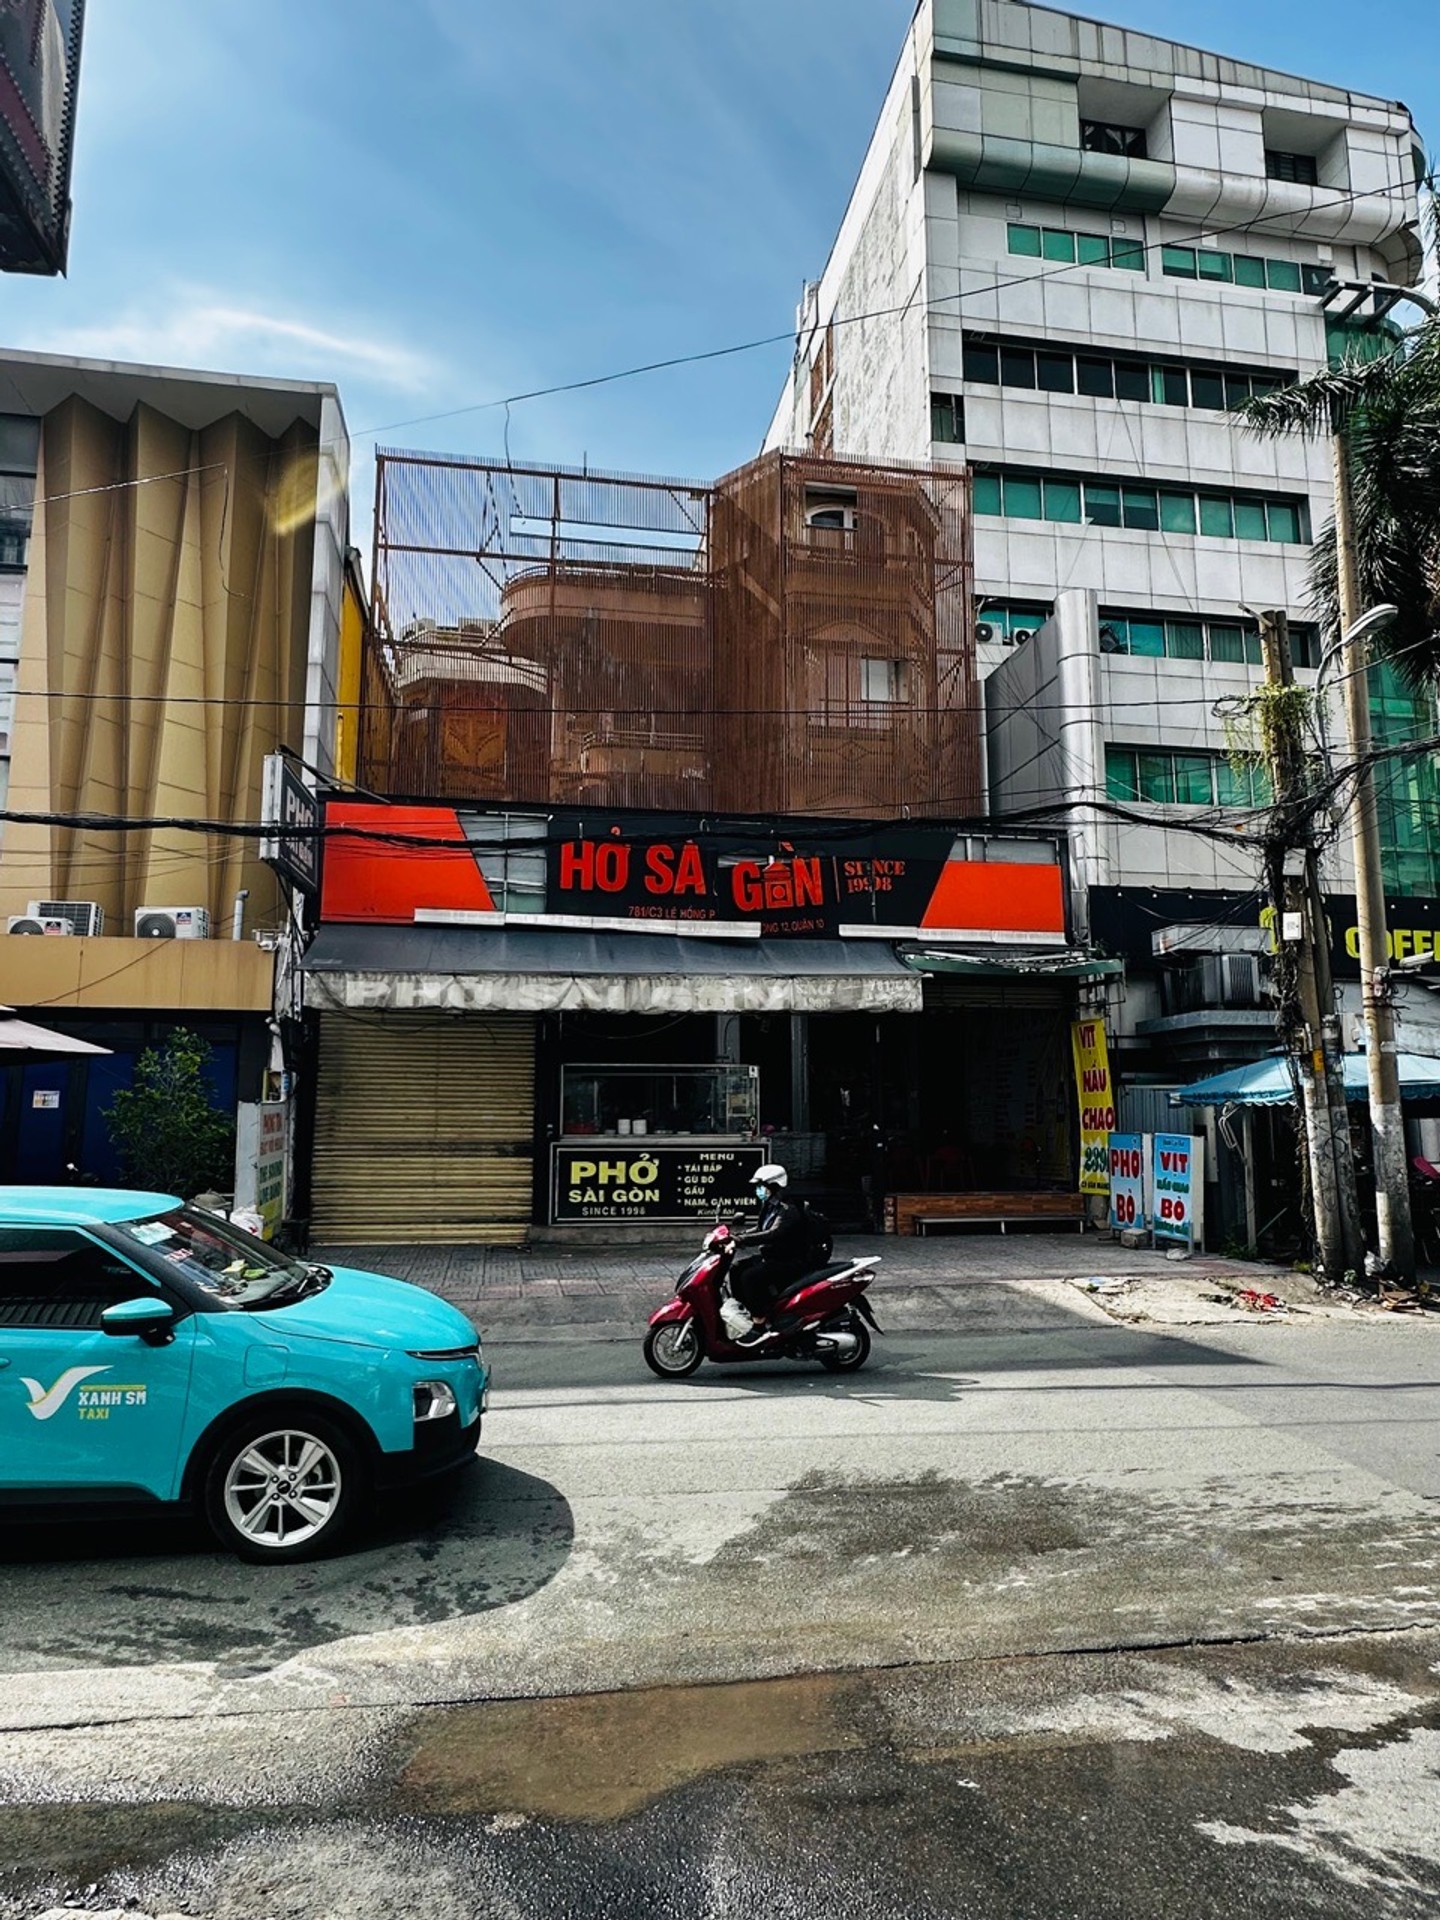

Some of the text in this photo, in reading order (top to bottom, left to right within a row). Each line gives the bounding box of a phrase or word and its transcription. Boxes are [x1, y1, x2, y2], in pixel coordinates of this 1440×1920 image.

[700, 1153, 735, 1161] MENU
[1160, 1151, 1188, 1177] VỊT
[570, 1153, 660, 1185] PHỞ
[568, 1186, 660, 1203] SÀI GÒN
[582, 1206, 617, 1216] SINCE
[1116, 1189, 1135, 1224] BÒ
[1161, 1196, 1185, 1221] BÒ
[78, 1391, 147, 1406] XANH SM
[78, 1408, 109, 1420] TAXI
